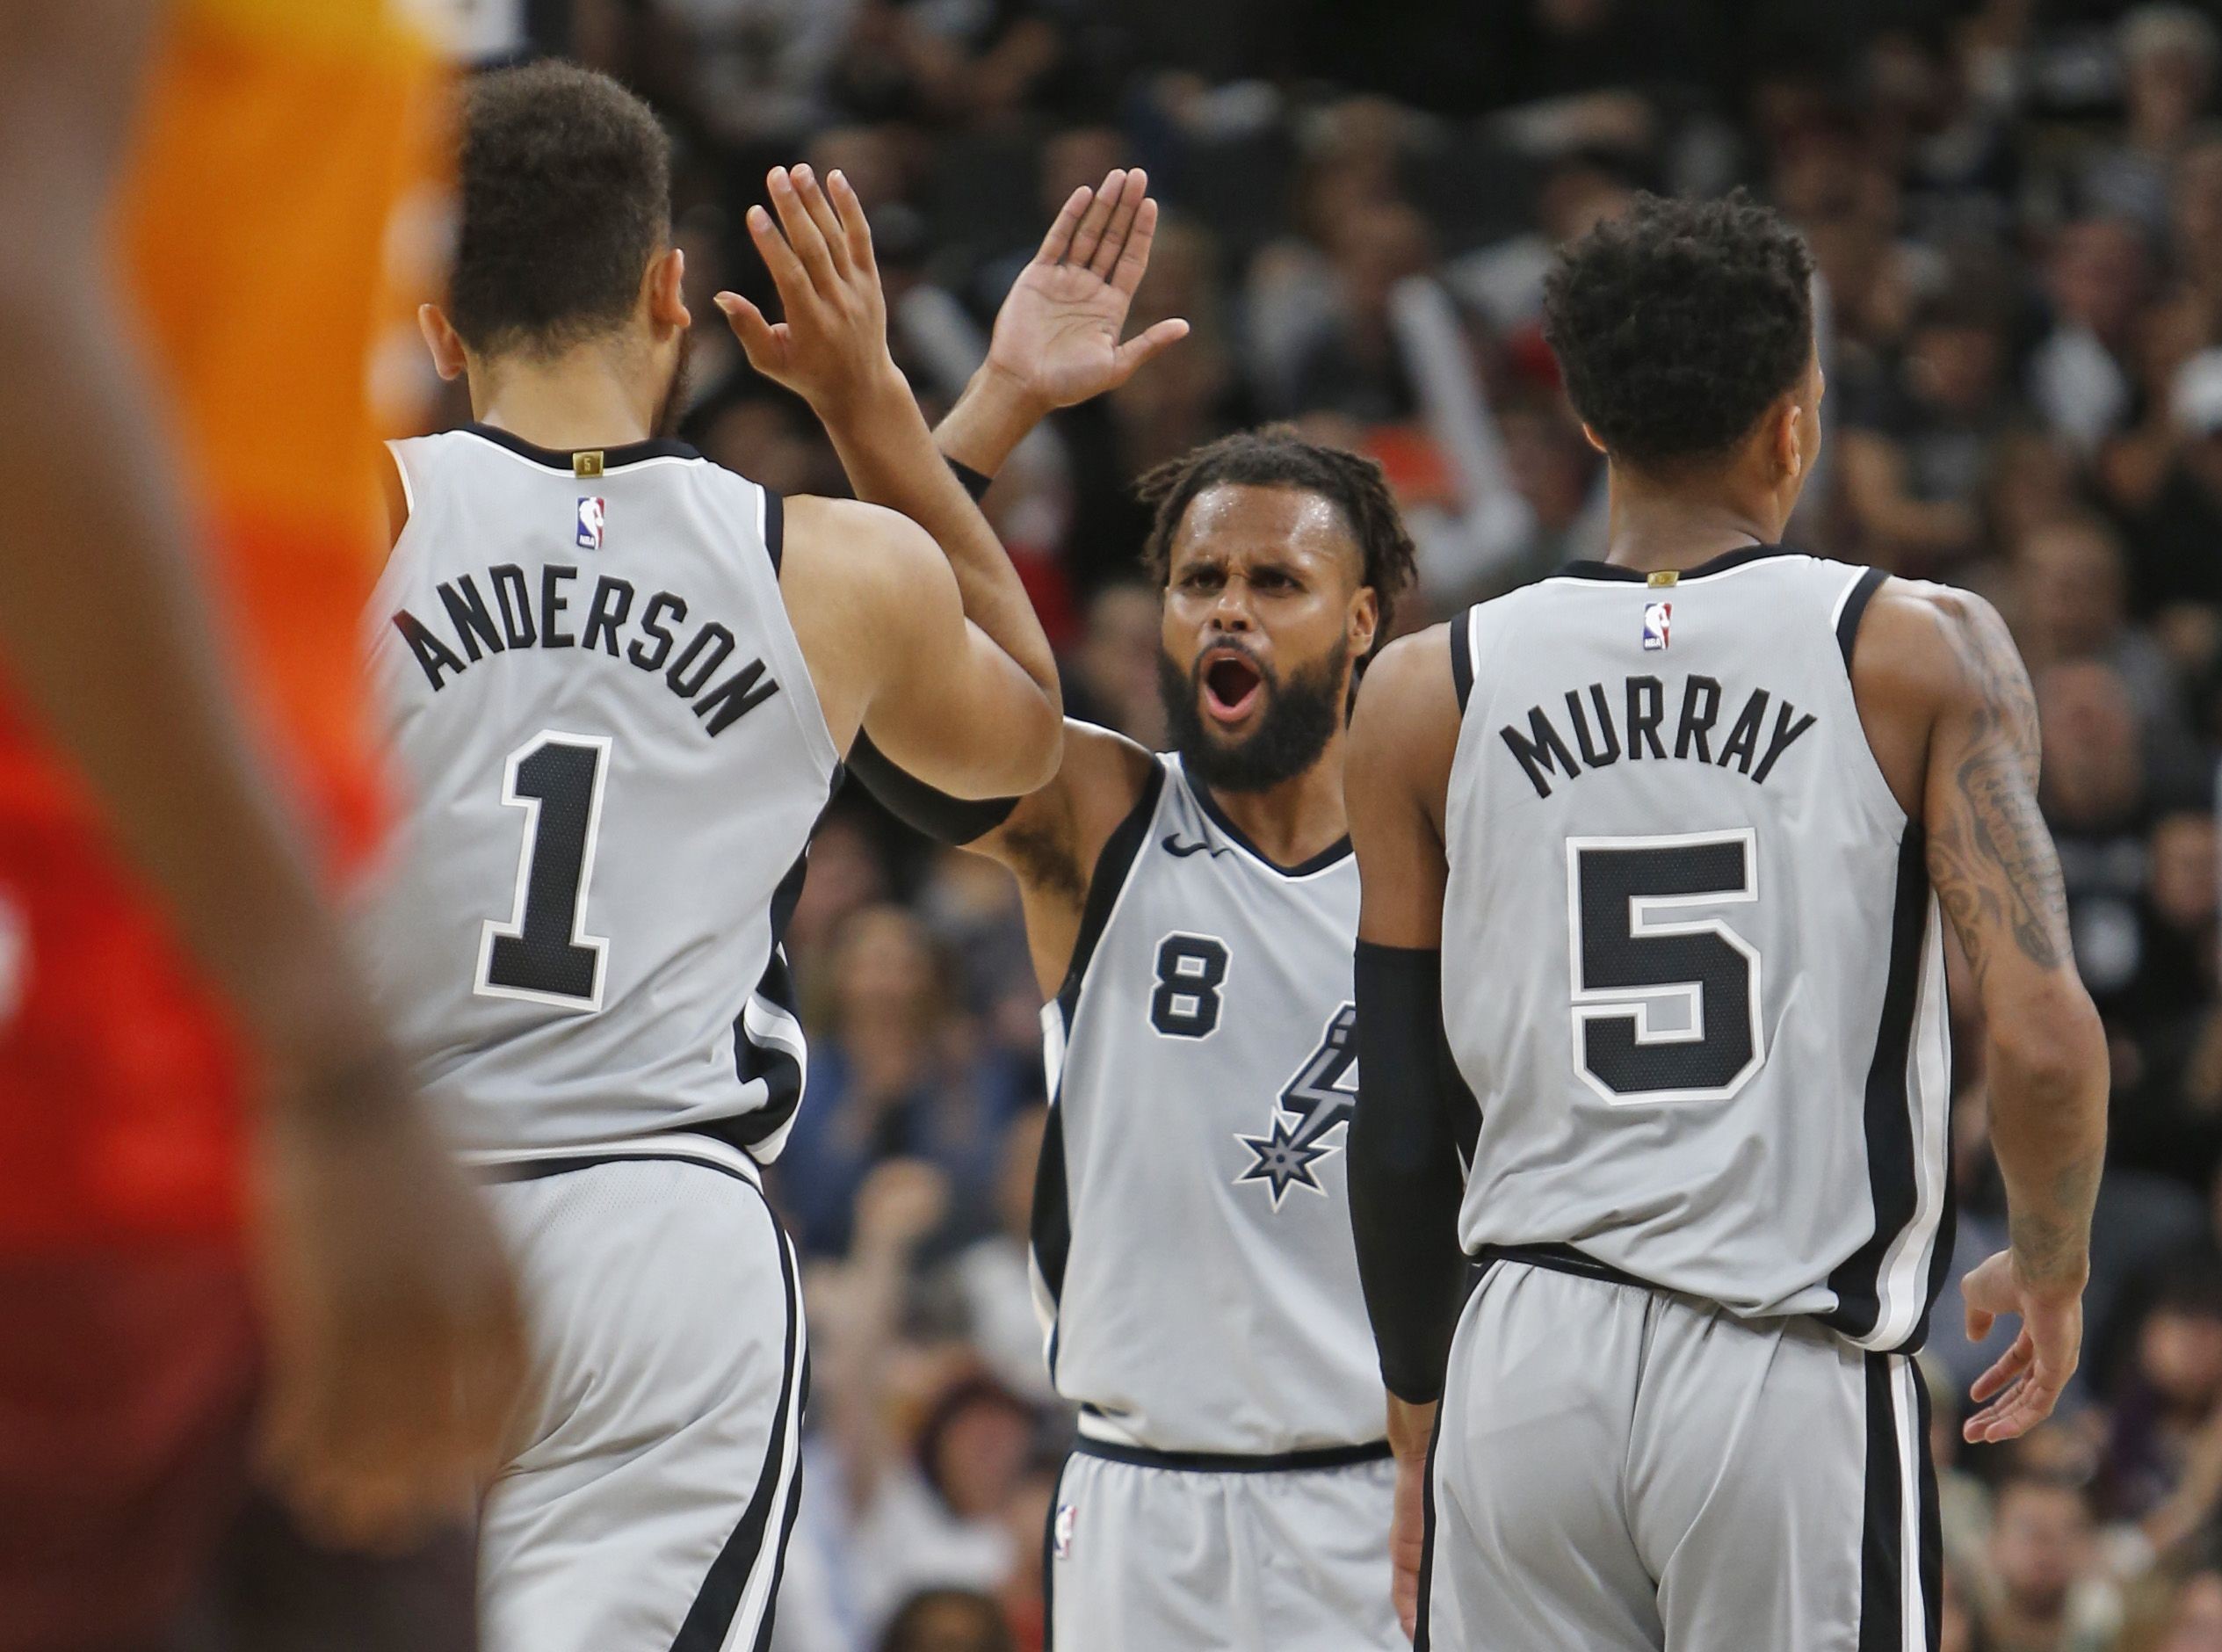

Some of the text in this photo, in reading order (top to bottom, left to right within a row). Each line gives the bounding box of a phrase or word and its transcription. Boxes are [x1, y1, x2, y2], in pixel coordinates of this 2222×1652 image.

[579, 534, 595, 546] NBA
[392, 563, 779, 737] ANDERSON
[1644, 637, 1661, 648] NBA
[1499, 674, 1817, 799] MURRAY
[473, 729, 613, 1012] 1
[1148, 931, 1232, 1040] 8
[1566, 829, 1767, 1105] 5
